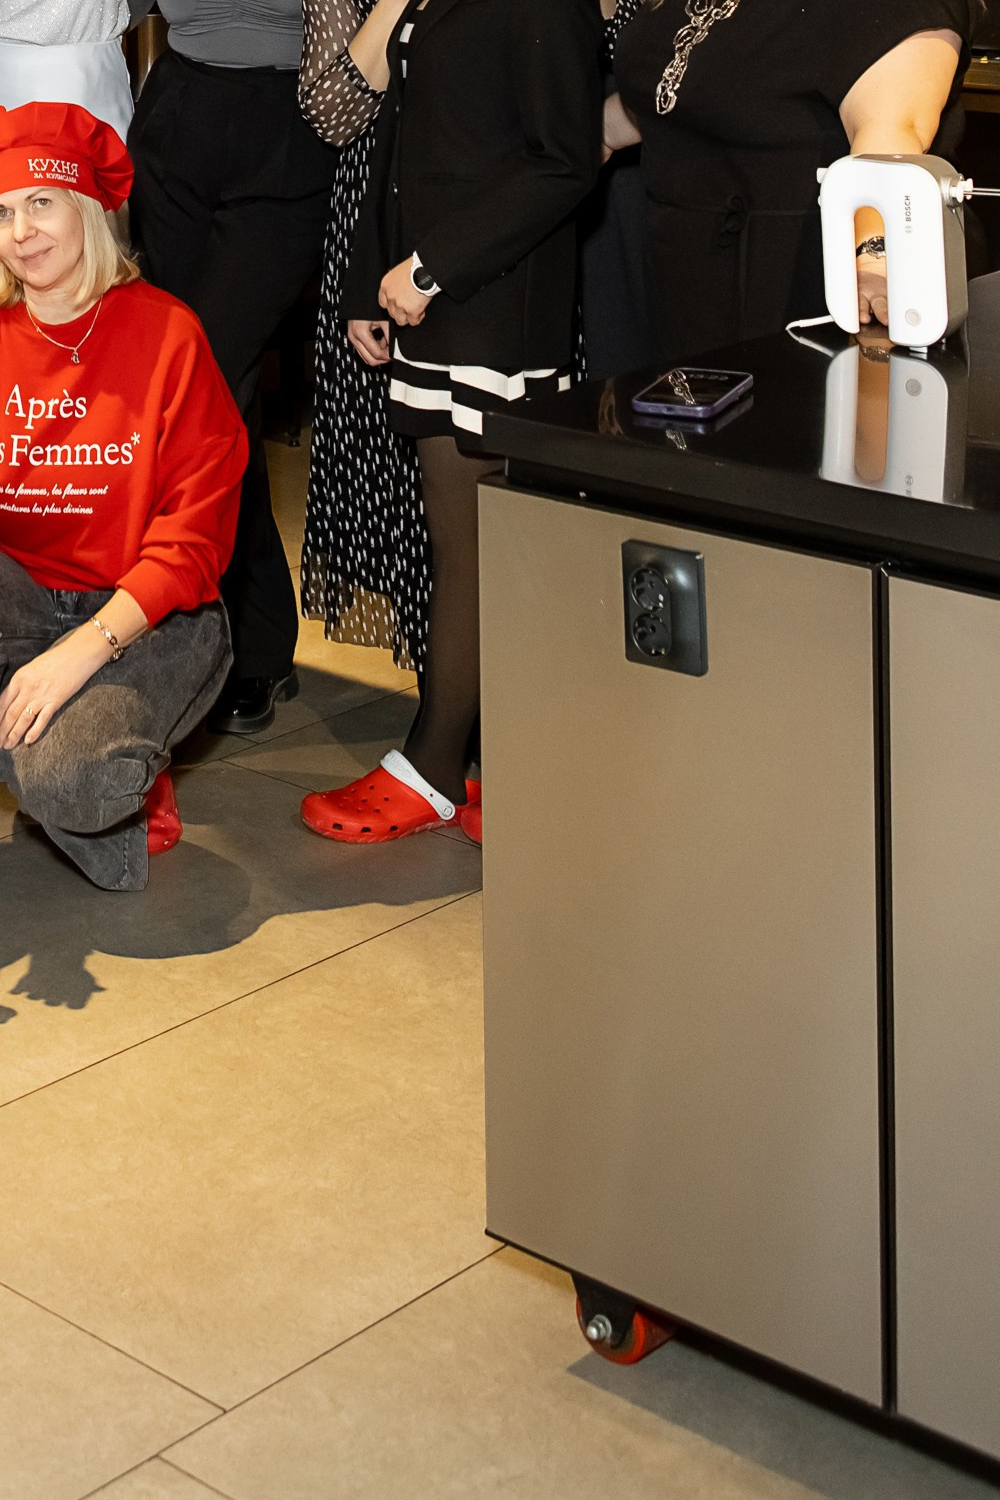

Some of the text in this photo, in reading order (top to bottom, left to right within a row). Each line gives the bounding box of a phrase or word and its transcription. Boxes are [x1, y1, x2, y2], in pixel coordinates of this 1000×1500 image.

[27, 158, 79, 177] КУХНЯ
[4, 383, 87, 430] Après
[63, 502, 94, 515] divines
